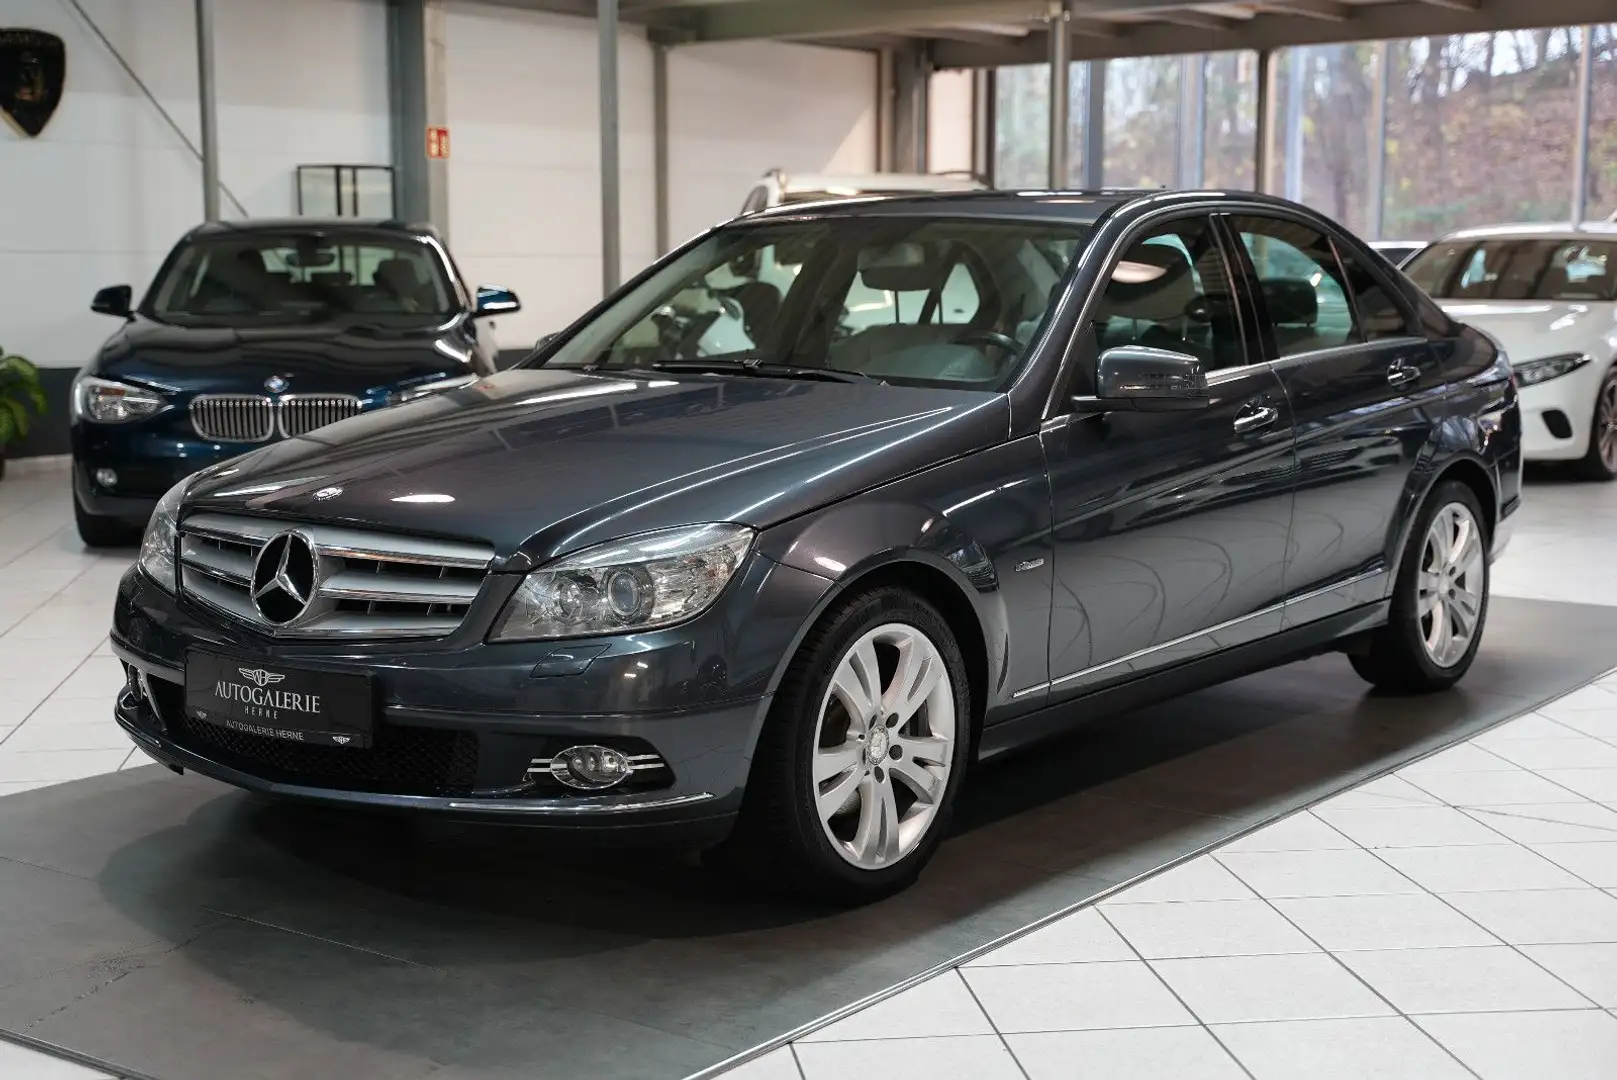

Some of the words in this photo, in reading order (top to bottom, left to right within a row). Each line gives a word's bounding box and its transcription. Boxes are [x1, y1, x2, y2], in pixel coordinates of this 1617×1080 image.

[214, 680, 321, 713] AUTOGALERIE
[244, 705, 278, 719] HERNE
[226, 719, 275, 737] AUTOGALERIE
[275, 729, 304, 741] HERNE
